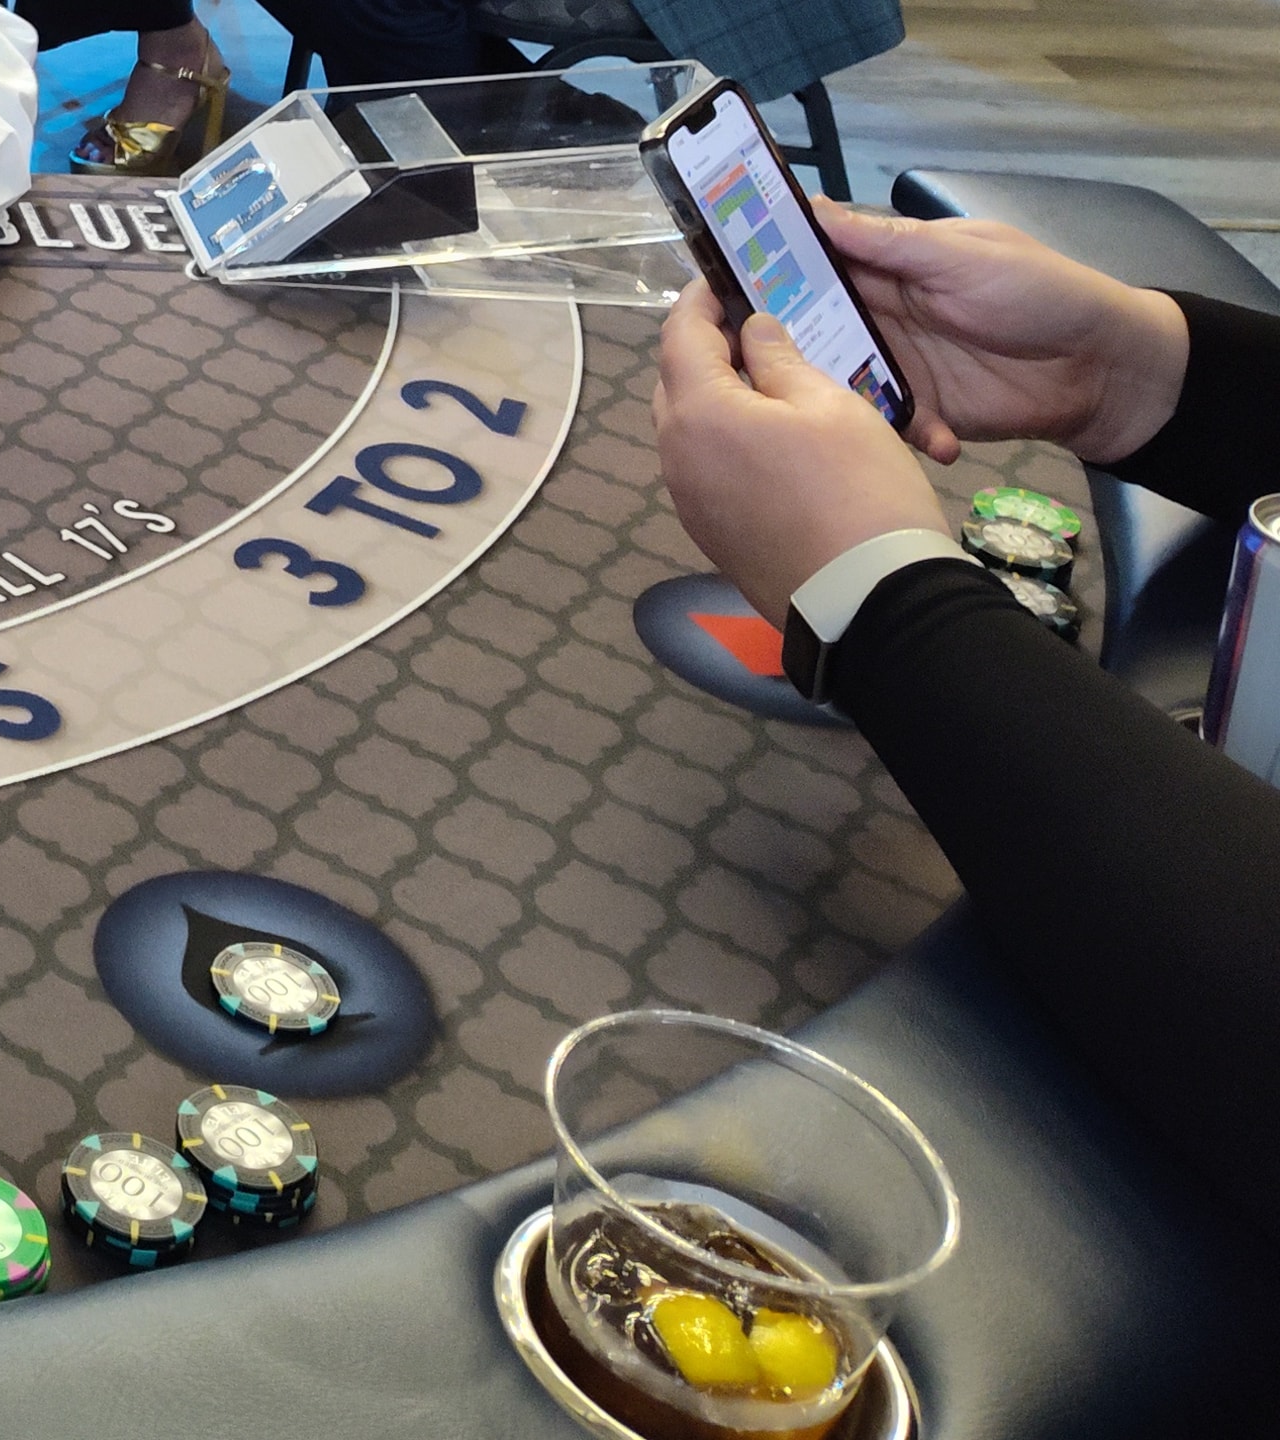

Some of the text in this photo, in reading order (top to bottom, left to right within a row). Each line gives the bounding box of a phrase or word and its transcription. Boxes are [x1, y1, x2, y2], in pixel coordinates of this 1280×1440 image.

[233, 379, 528, 609] 3 TO 2
[59, 498, 177, 561] 17'S
[248, 971, 302, 1003] 100
[218, 1118, 275, 1158] 100
[99, 1162, 165, 1208] 100
